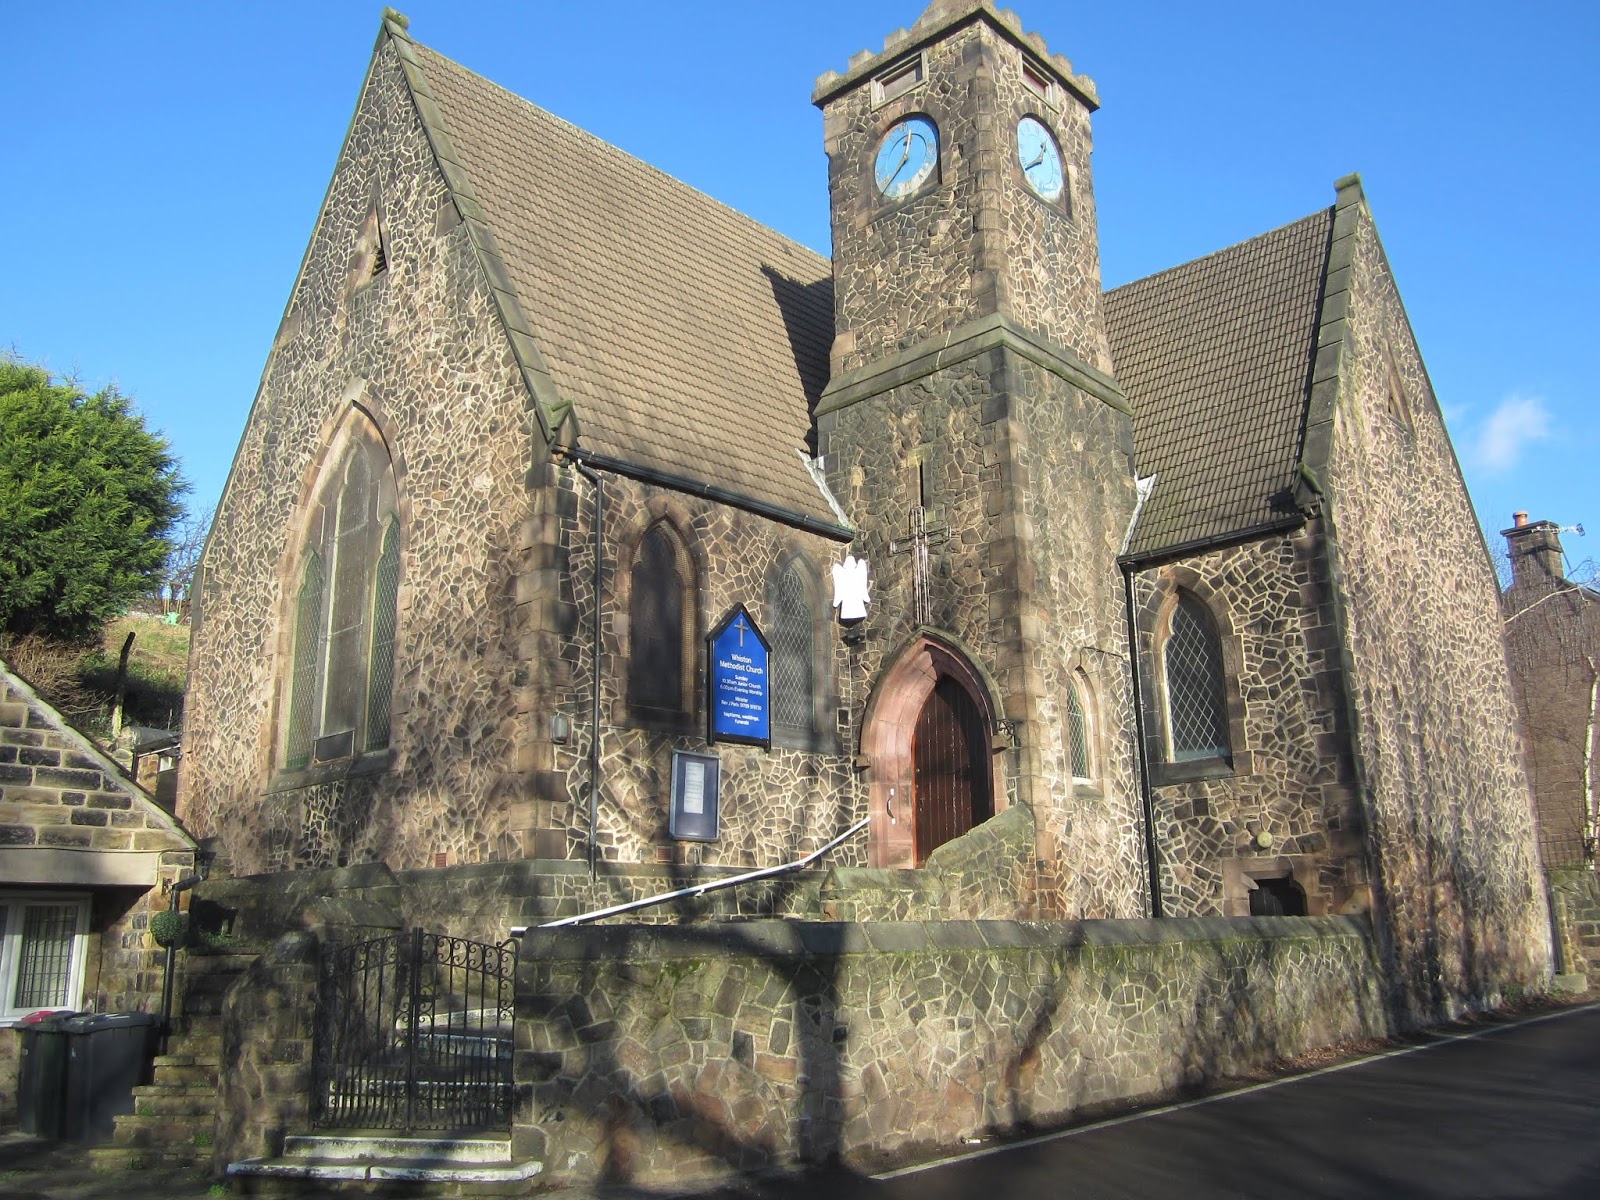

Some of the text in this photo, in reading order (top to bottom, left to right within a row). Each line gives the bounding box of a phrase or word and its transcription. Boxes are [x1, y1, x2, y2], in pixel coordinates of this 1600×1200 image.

[731, 654, 752, 663] Whiston
[720, 660, 763, 674] Methodist Church
